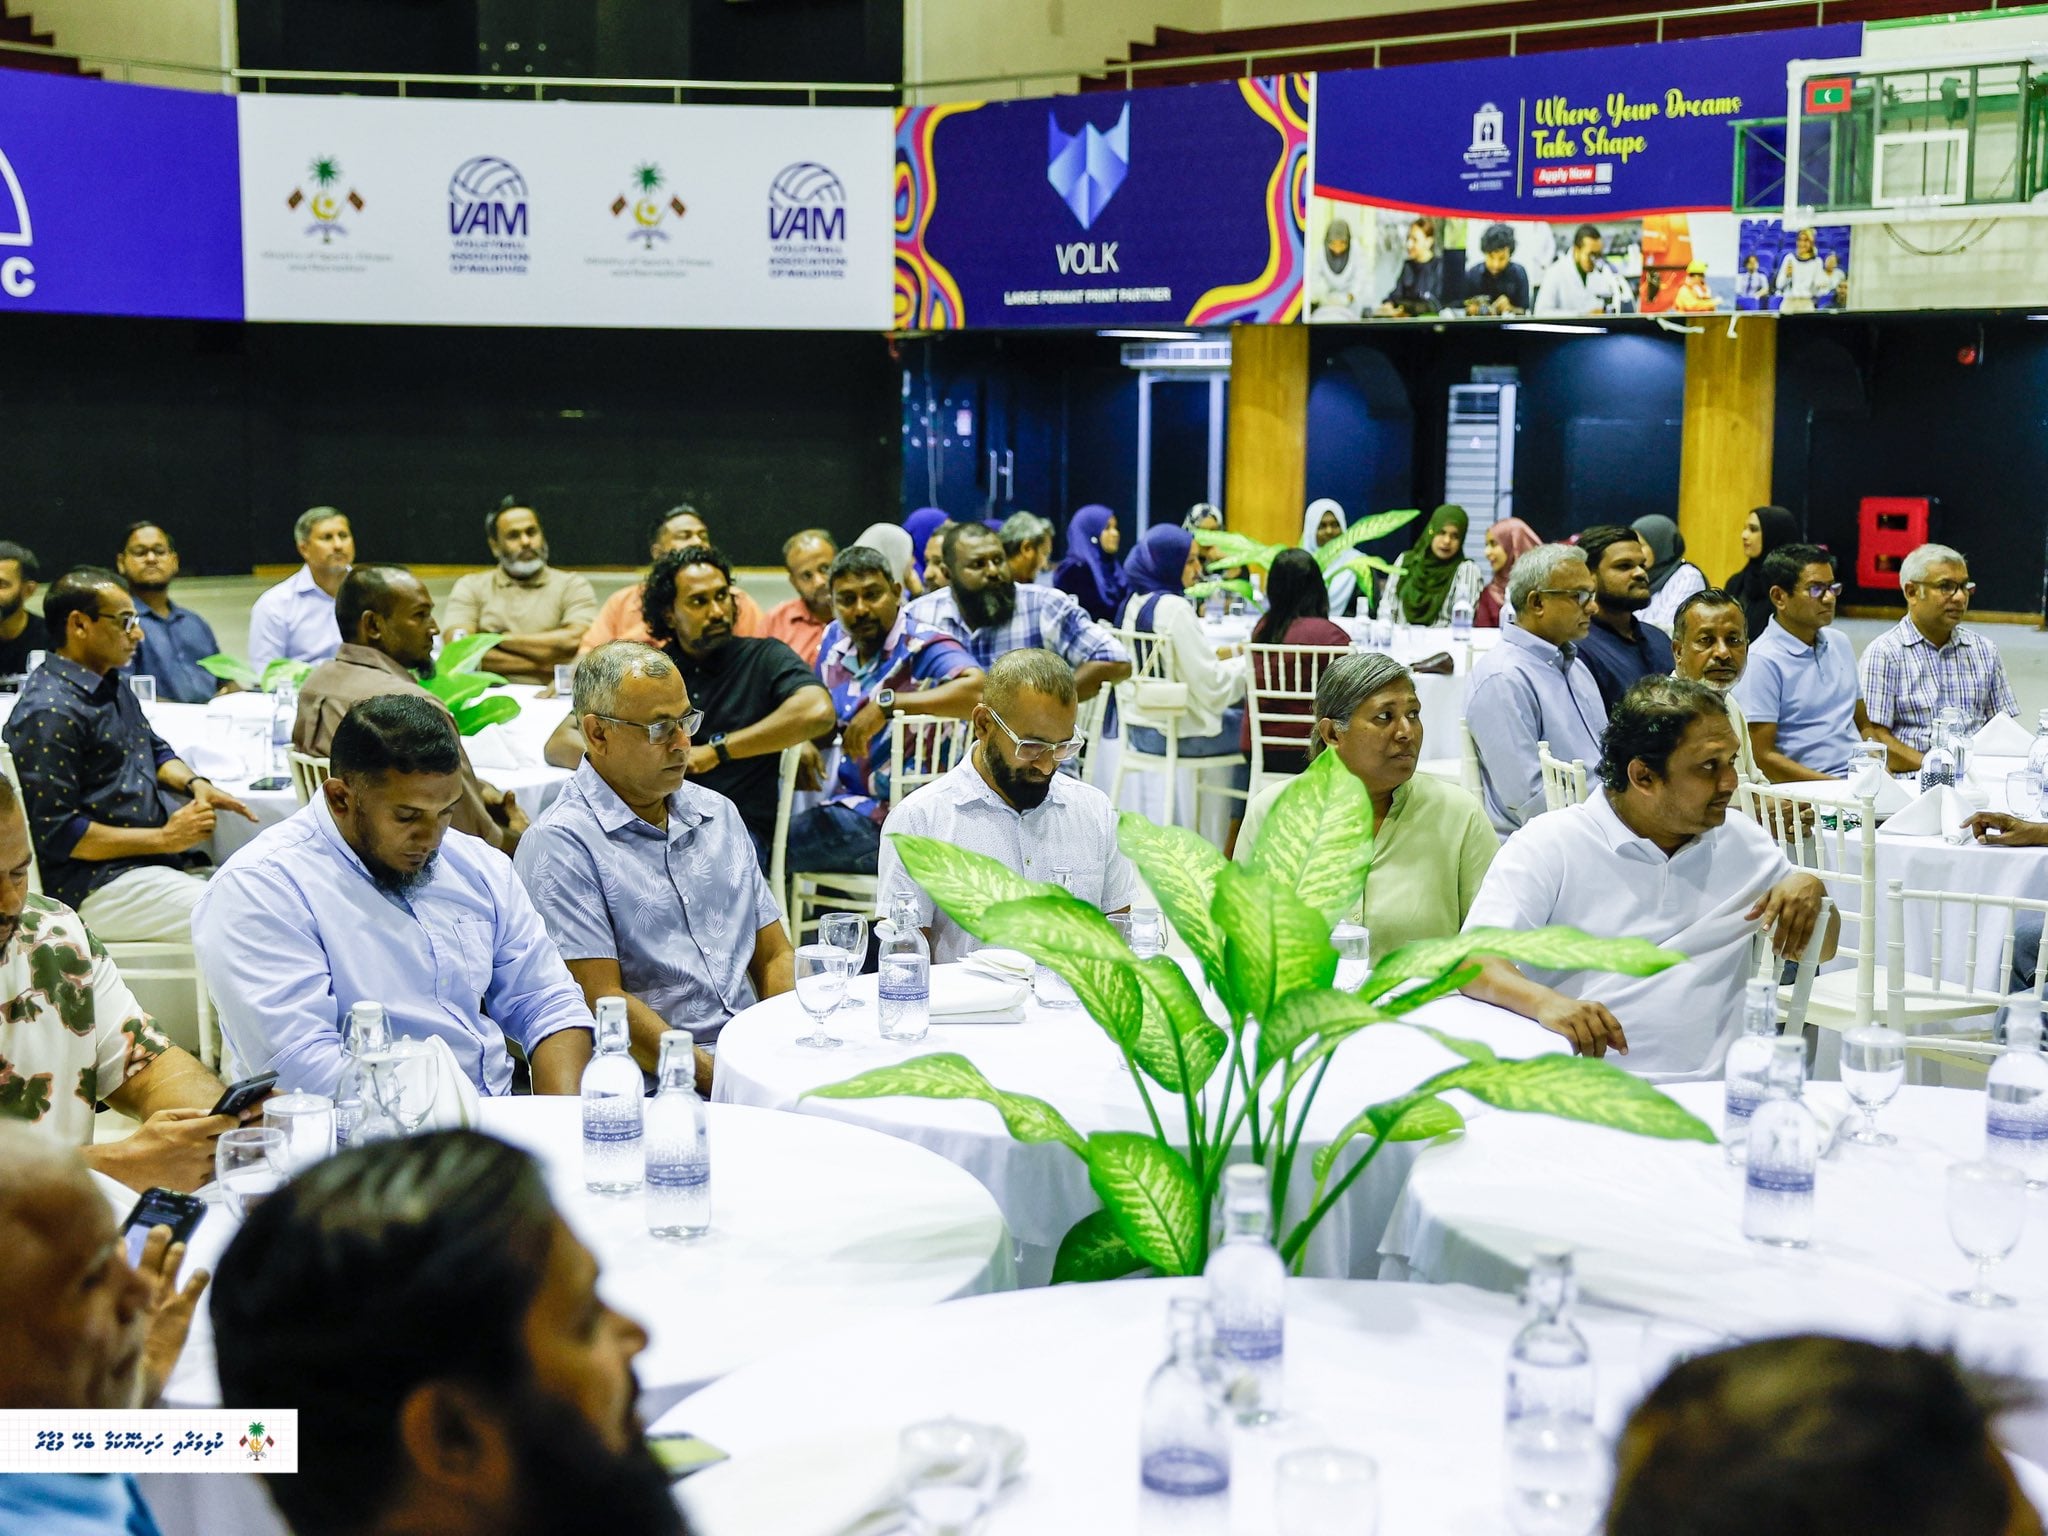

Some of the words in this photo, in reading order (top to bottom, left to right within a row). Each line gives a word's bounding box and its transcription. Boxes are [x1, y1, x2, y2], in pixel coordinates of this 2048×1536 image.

[1535, 95, 1601, 127] Where
[1606, 92, 1660, 128] Your
[1664, 88, 1743, 119] Dreams
[1531, 128, 1578, 159] Take
[1582, 125, 1648, 164] Shape
[1538, 167, 1568, 184] Apply
[1568, 167, 1593, 180] Now
[450, 202, 527, 235] VAM
[770, 207, 844, 240] VAM
[1055, 241, 1120, 275] VOLK
[1084, 288, 1118, 304] PRINT
[1118, 286, 1172, 303] PARTNER
